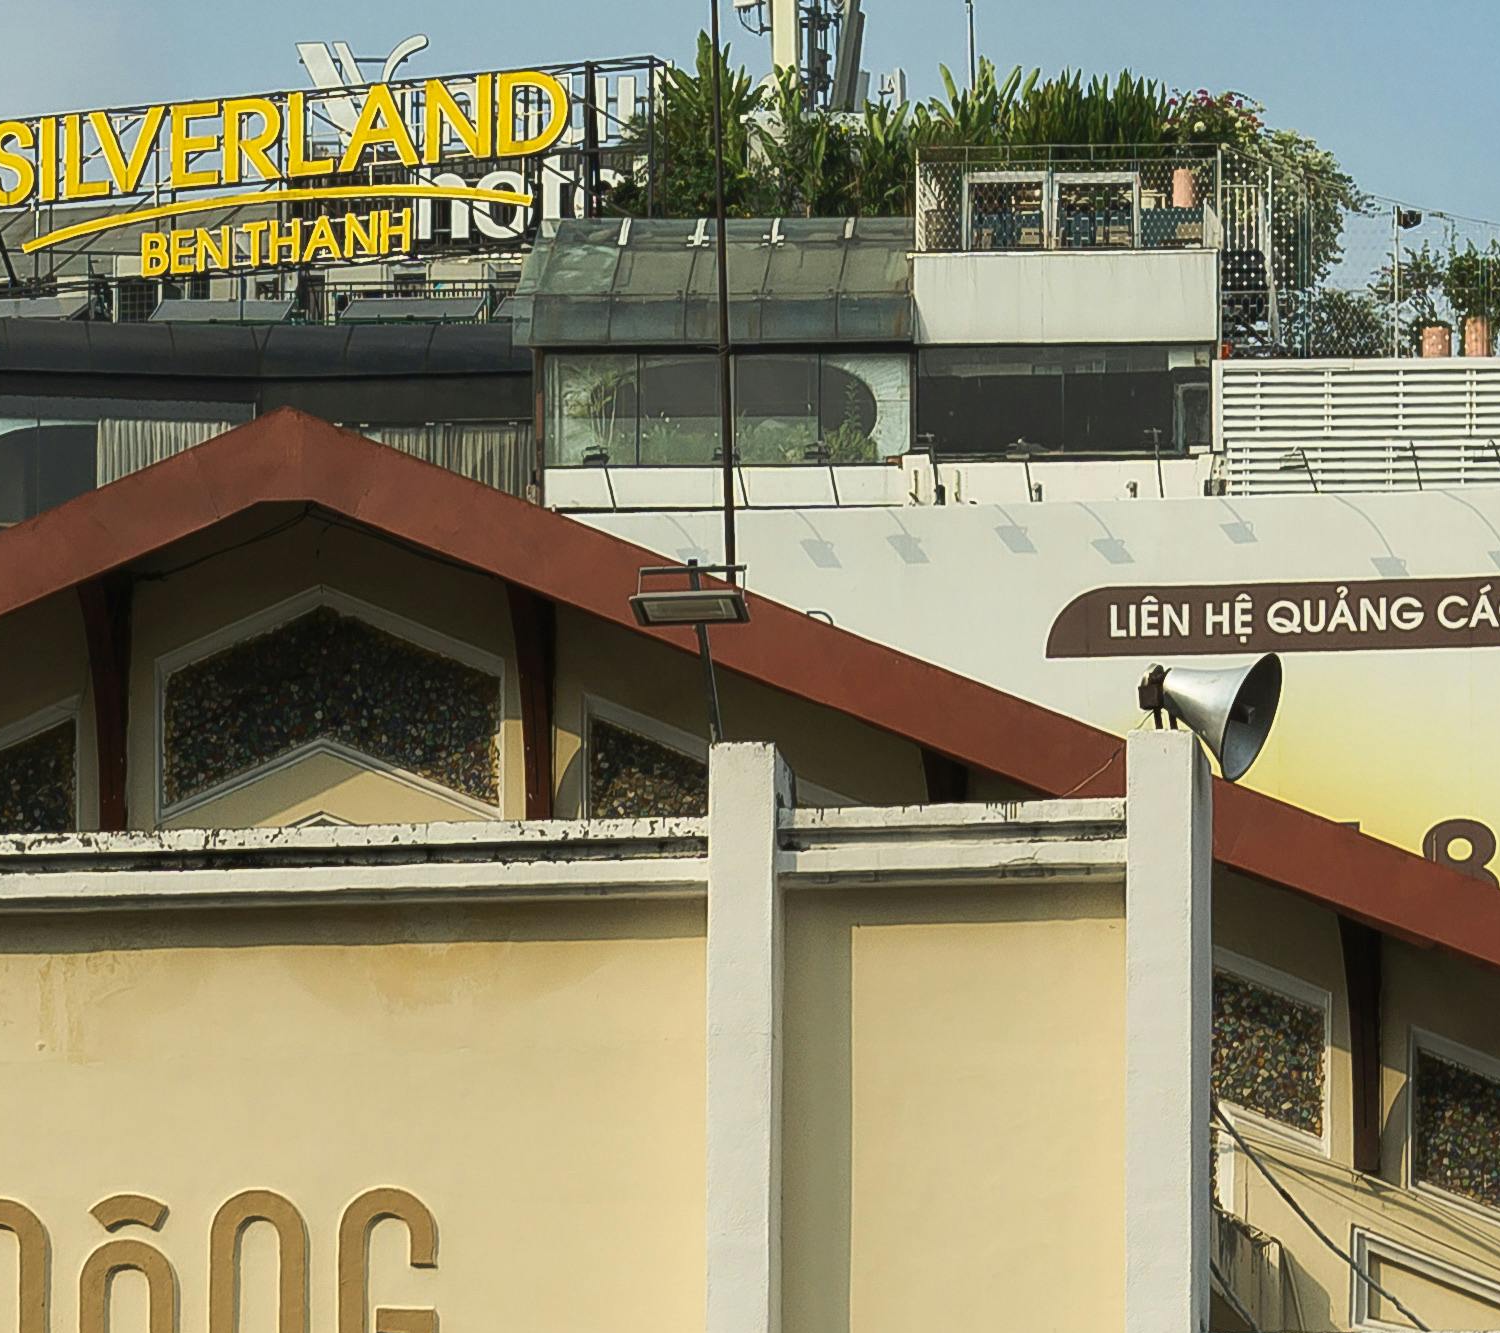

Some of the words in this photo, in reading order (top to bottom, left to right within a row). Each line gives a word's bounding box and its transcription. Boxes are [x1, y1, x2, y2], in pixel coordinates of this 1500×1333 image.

[141, 228, 231, 277] BEN
[244, 208, 412, 267] THANH
[1110, 595, 1190, 638] LIÊN
[1205, 593, 1253, 643] HỆ
[1266, 585, 1425, 634] QUẢNG
